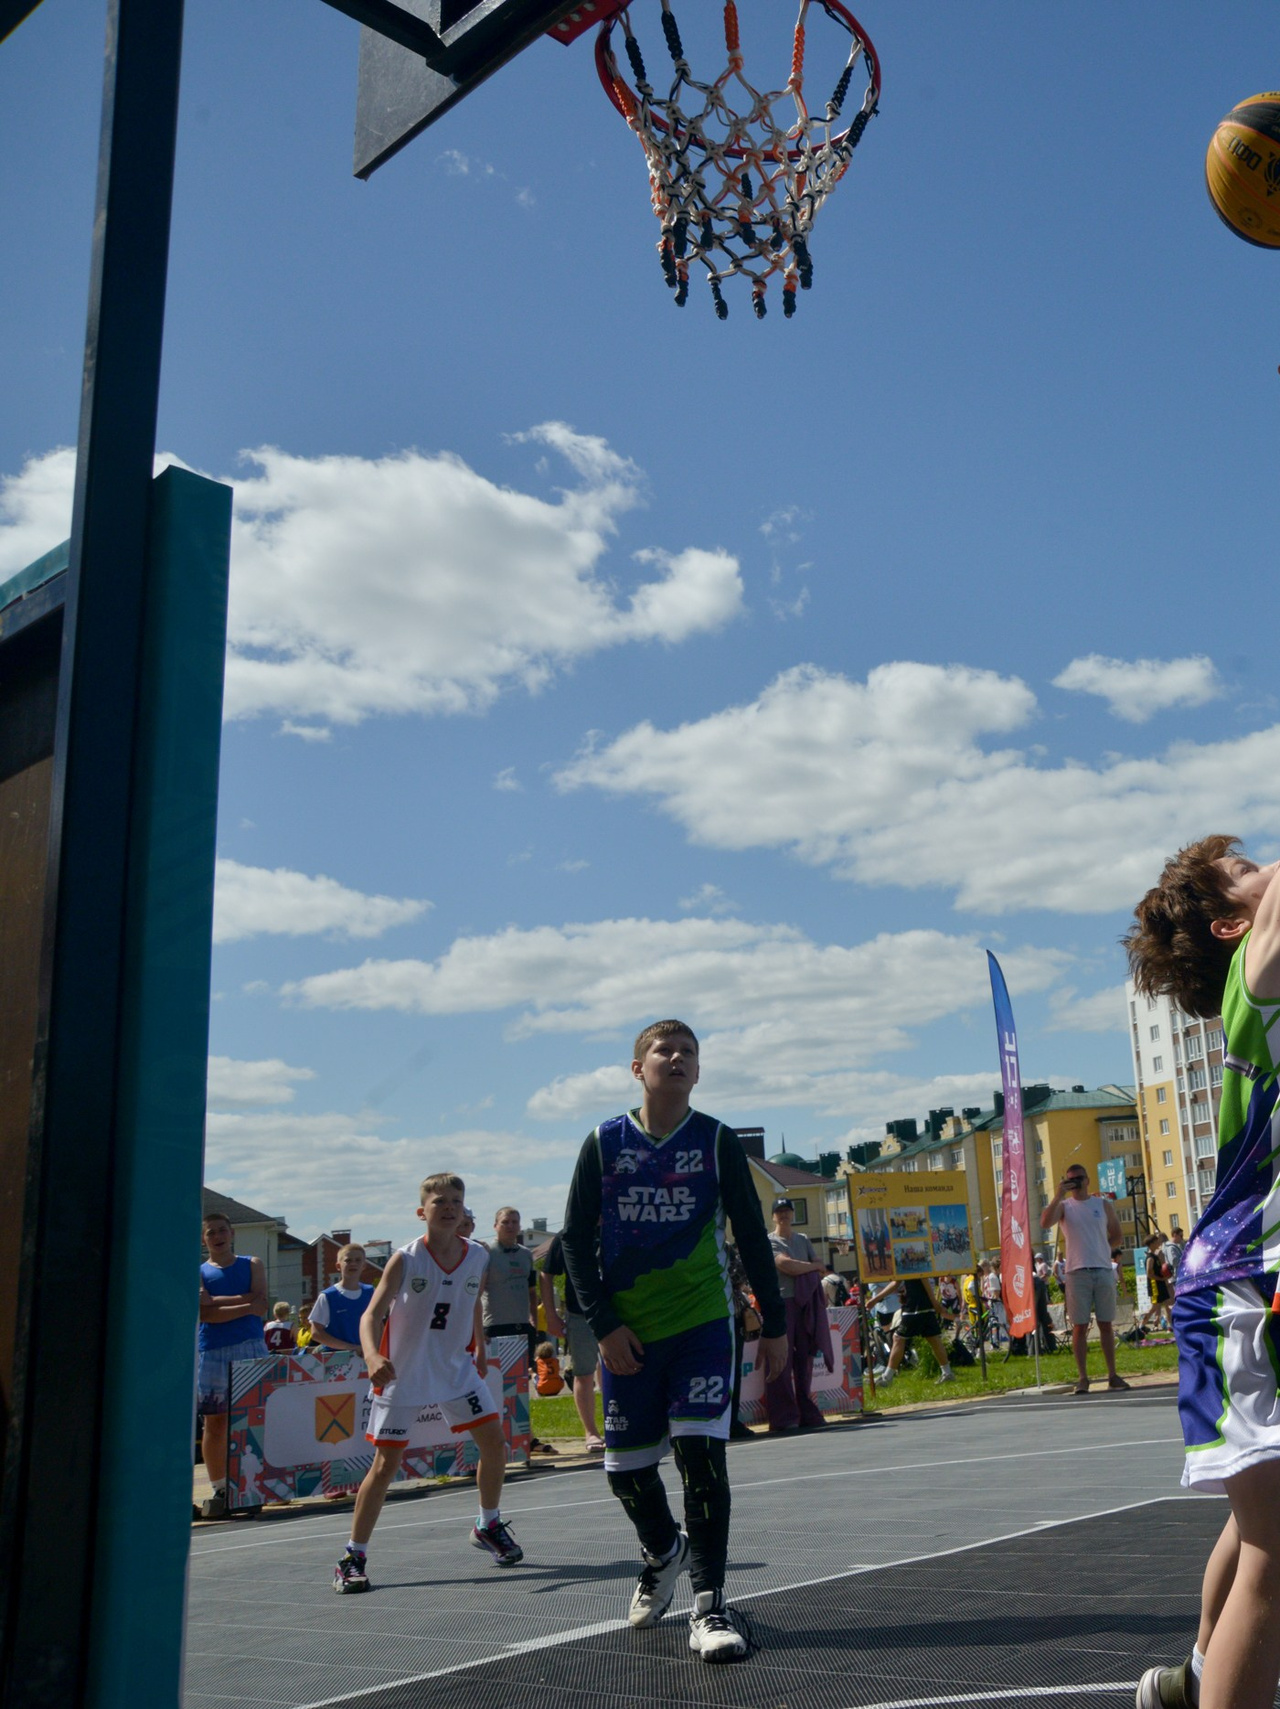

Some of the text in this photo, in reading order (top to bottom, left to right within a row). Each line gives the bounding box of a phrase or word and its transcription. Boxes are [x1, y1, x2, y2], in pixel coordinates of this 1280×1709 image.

[675, 1149, 704, 1173] 22
[618, 1186, 697, 1205] STAR
[904, 1184, 954, 1193] Наша команда
[618, 1203, 696, 1222] WARS
[430, 1302, 451, 1330] 8
[270, 1330, 282, 1347] 4
[688, 1375, 724, 1403] 22
[379, 1428, 408, 1436] STURDY
[604, 1423, 629, 1431] WARS
